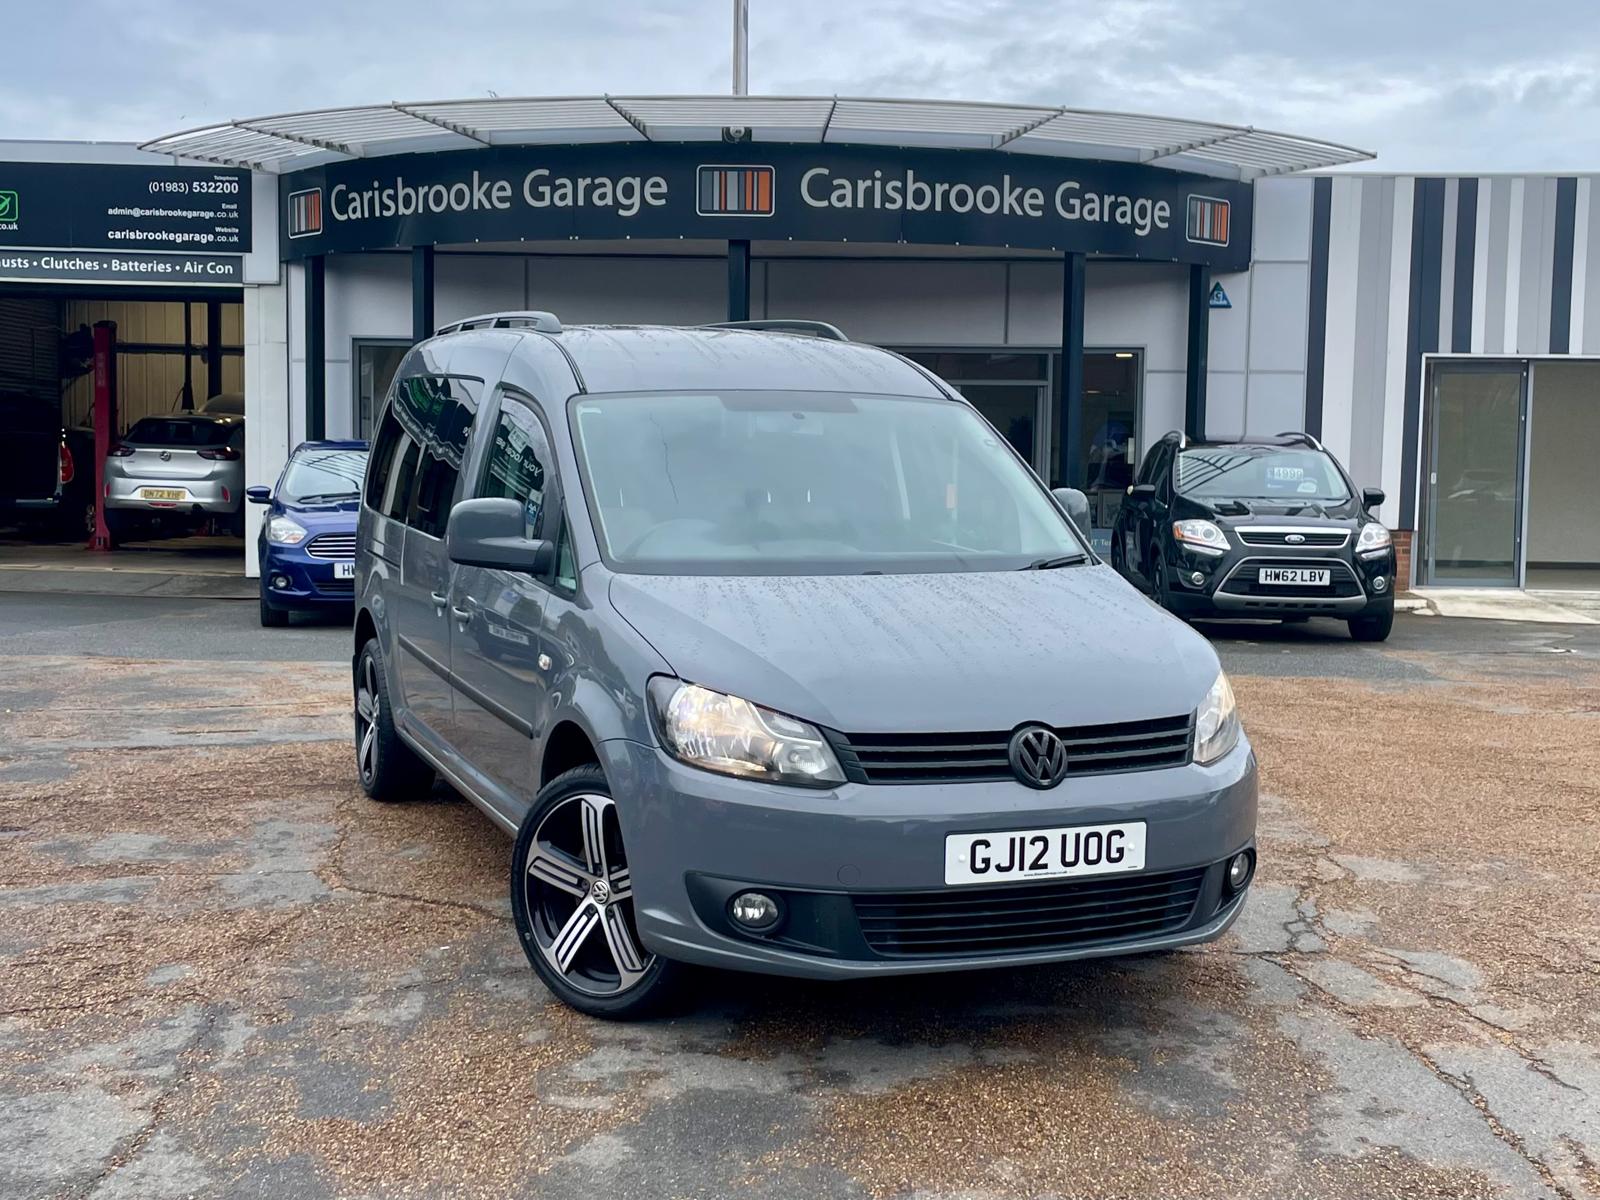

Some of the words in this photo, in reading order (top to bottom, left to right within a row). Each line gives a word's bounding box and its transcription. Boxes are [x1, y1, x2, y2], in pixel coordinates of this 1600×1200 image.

[148, 181, 189, 195] (01983)
[192, 181, 239, 194] 532200
[331, 170, 512, 222] Carisbrooke
[523, 168, 668, 217] Garage
[800, 167, 1043, 218] Carisbrooke
[1055, 180, 1171, 236] Garage
[108, 207, 239, 219] admin@carisbrookegarage.co.uk
[108, 230, 239, 244] carisbrookegarage.co.uk
[0, 257, 29, 269] usts
[41, 256, 99, 270] Clutches
[112, 259, 172, 273] Batteries
[184, 261, 204, 274] Air
[207, 262, 233, 274] Con
[1264, 569, 1298, 582] HW62
[1300, 571, 1325, 583] LBV
[970, 835, 1049, 875] GJ12
[1060, 829, 1125, 869] UOG
